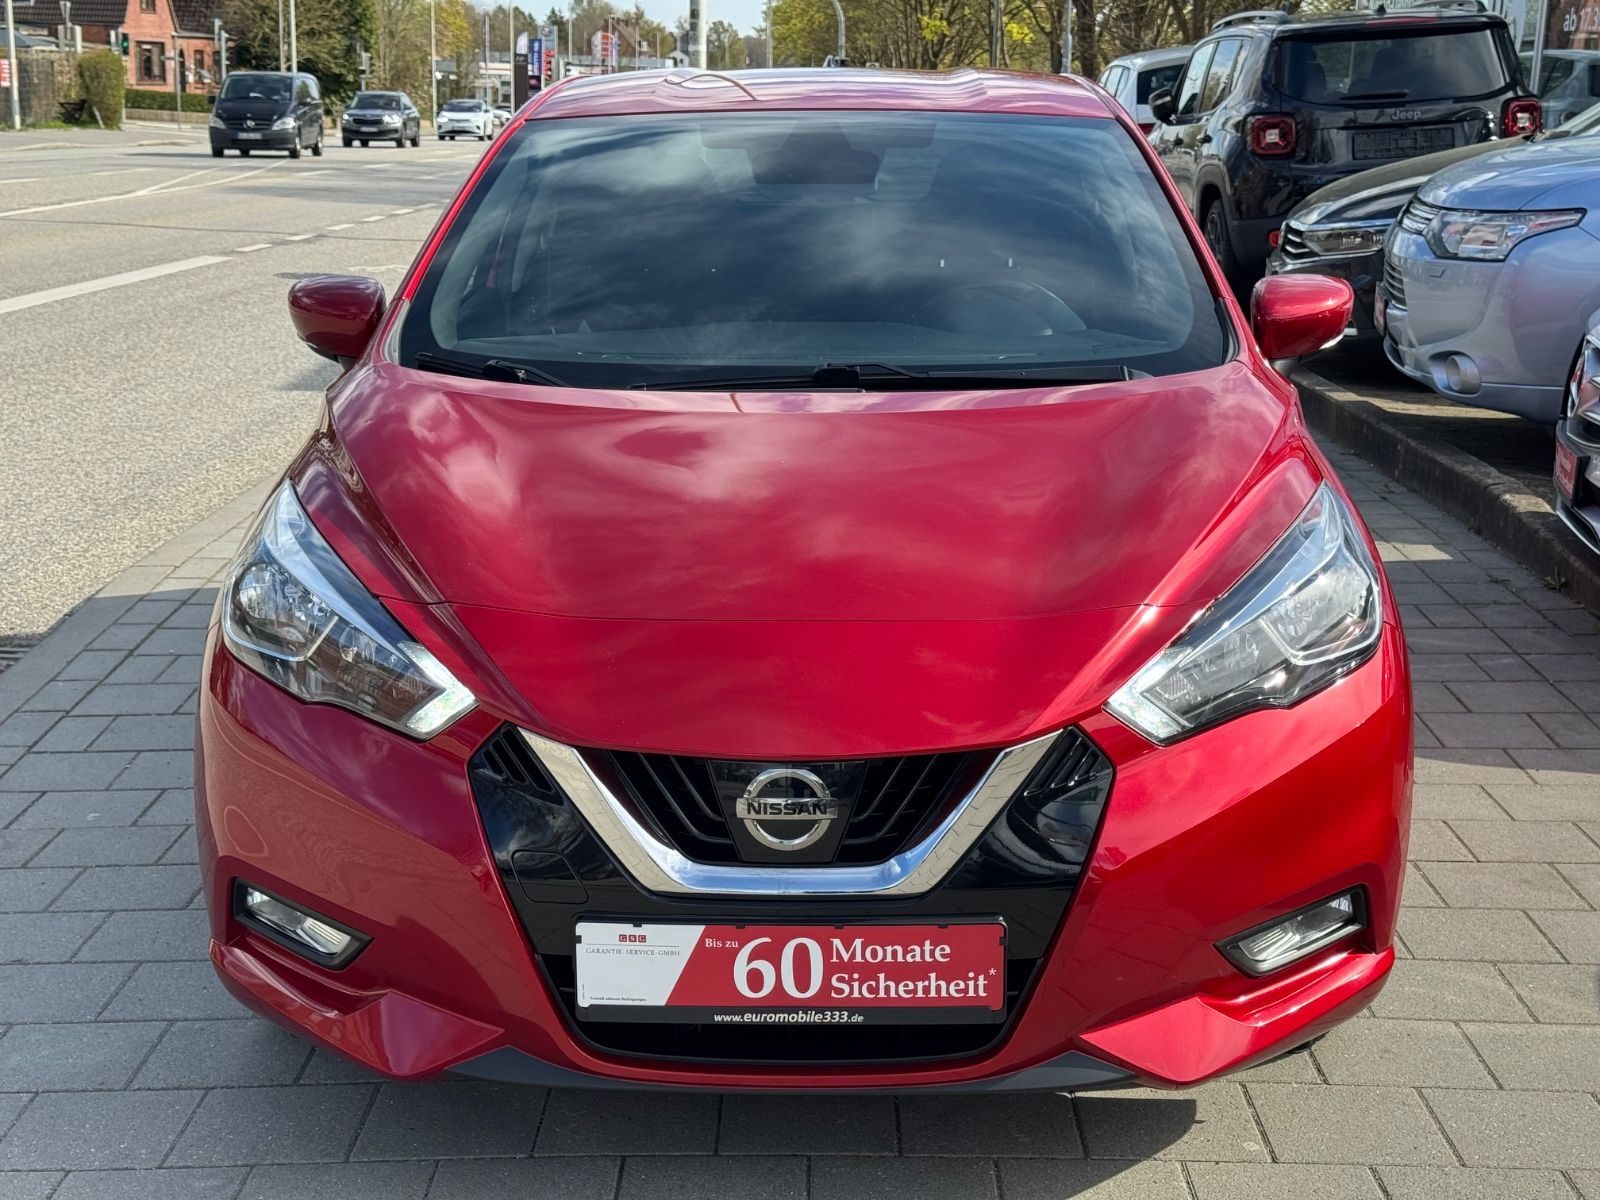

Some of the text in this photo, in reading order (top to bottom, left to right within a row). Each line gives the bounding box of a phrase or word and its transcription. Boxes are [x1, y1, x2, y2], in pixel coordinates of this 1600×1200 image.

[1563, 7, 1600, 32] ab 17.3
[1391, 110, 1422, 121] Jeep
[747, 802, 828, 816] NISSAN
[705, 938, 723, 948] Bis
[829, 938, 951, 963] Monate
[733, 937, 824, 999] 60
[713, 1010, 864, 1024] www.euromobile333.de
